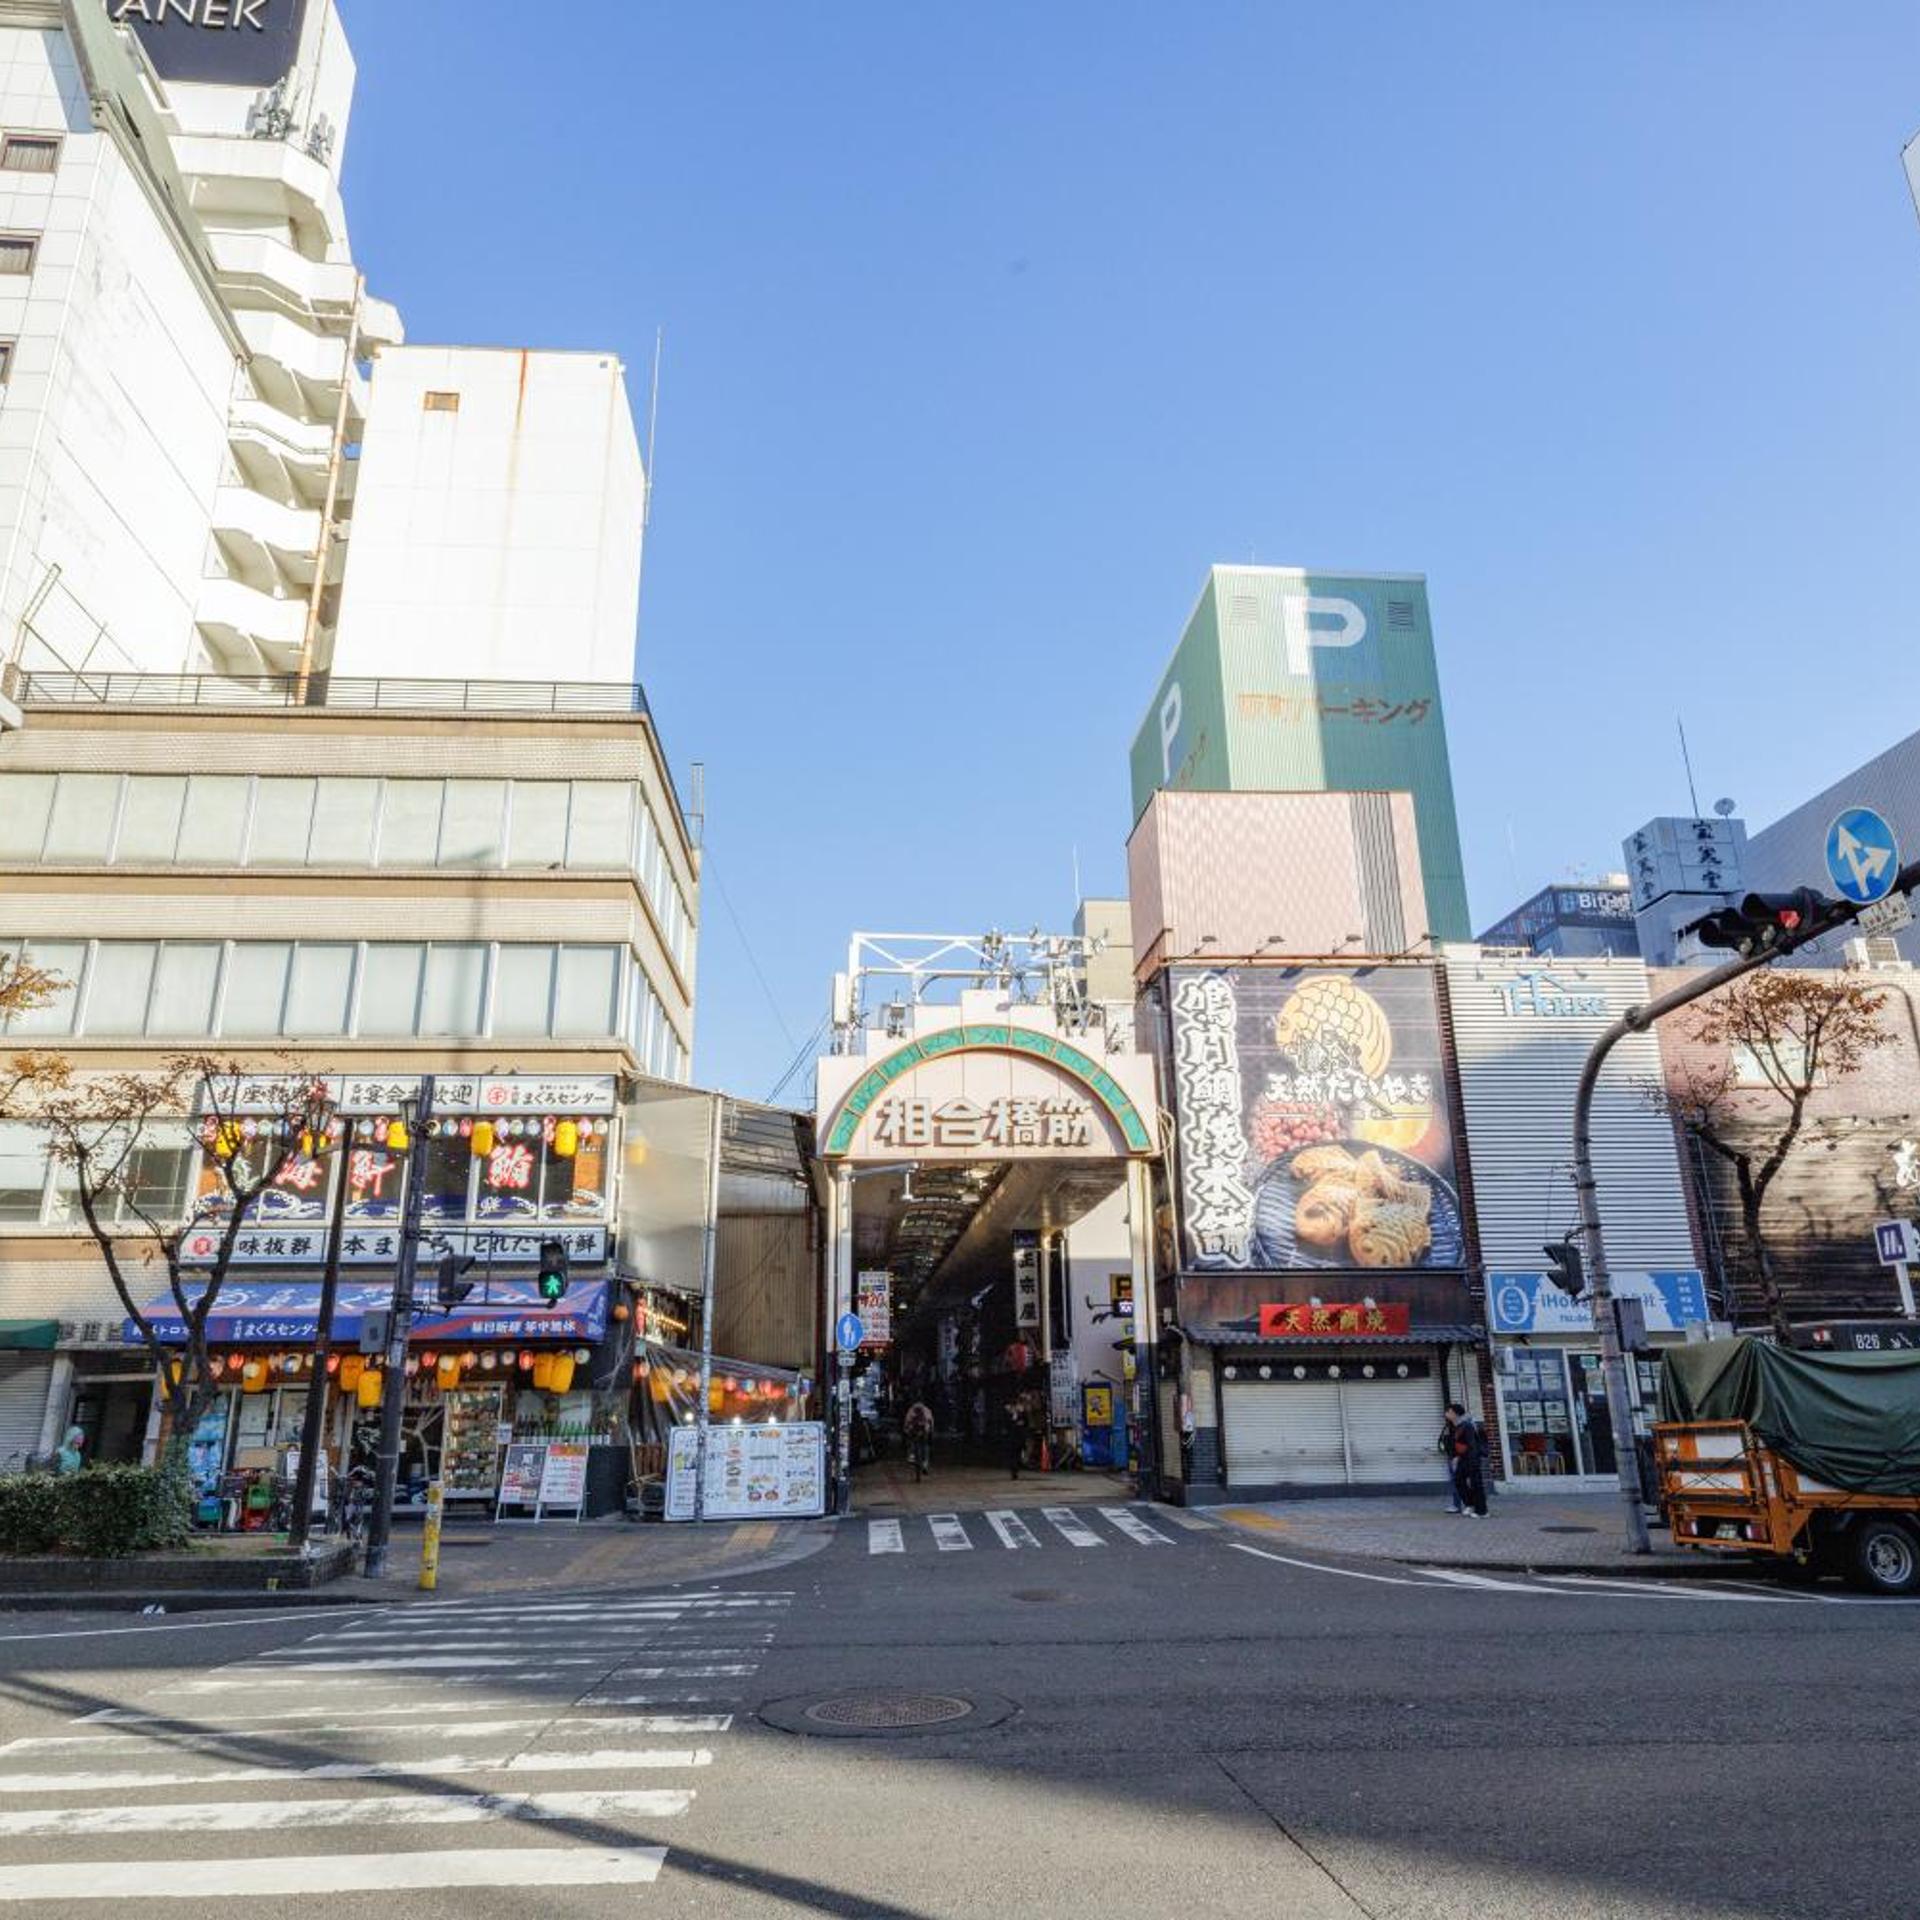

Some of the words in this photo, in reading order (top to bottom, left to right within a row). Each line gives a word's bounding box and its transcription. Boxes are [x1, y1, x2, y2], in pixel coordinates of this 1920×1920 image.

[1284, 596, 1367, 676] P
[873, 1097, 1092, 1148] 相合橋筋
